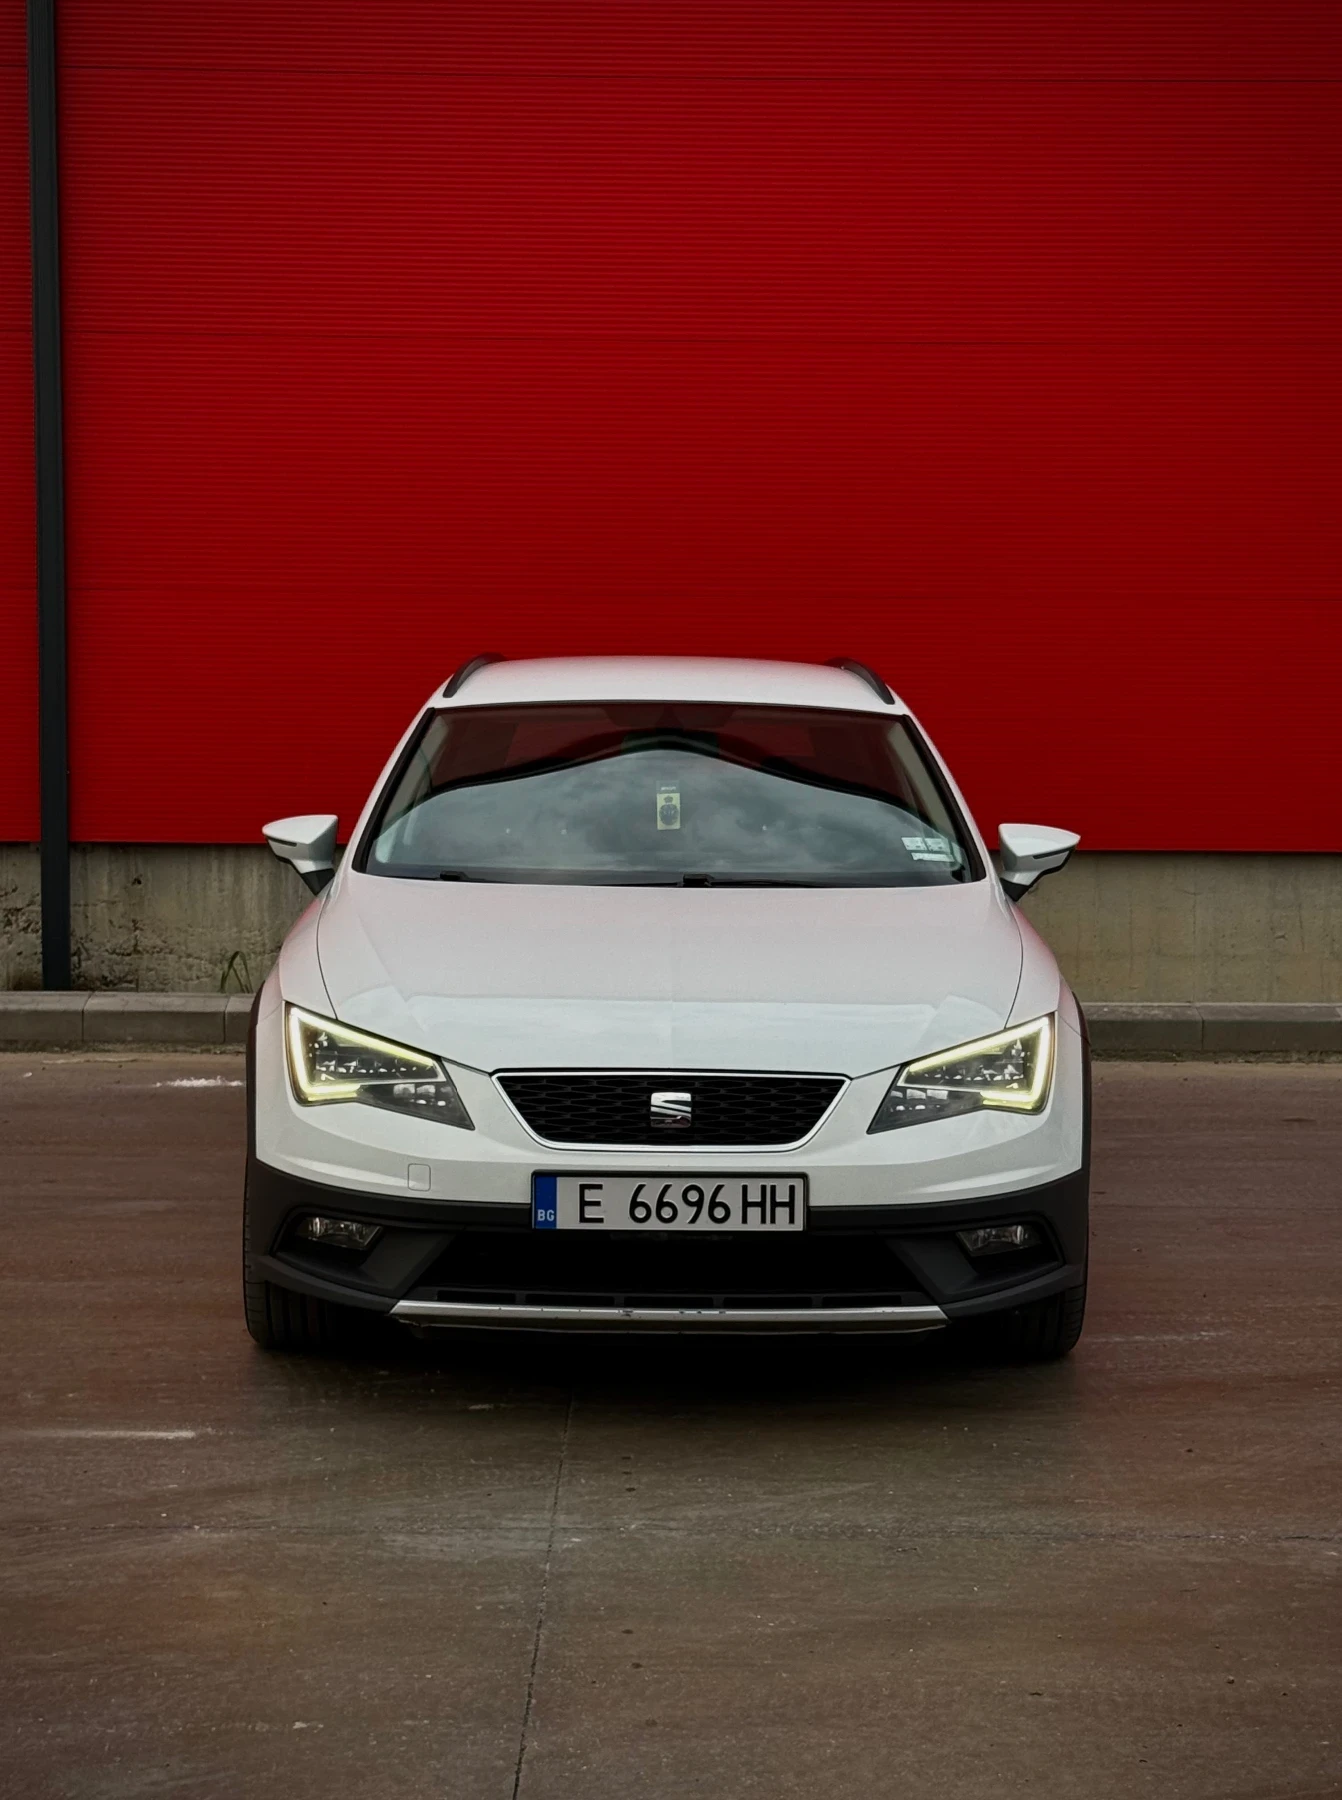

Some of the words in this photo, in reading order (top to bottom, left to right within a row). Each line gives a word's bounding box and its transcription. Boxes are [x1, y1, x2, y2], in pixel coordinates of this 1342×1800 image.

[537, 1209, 555, 1221] BG
[578, 1183, 604, 1224] E
[629, 1184, 731, 1224] 6696
[741, 1184, 795, 1224] HH
